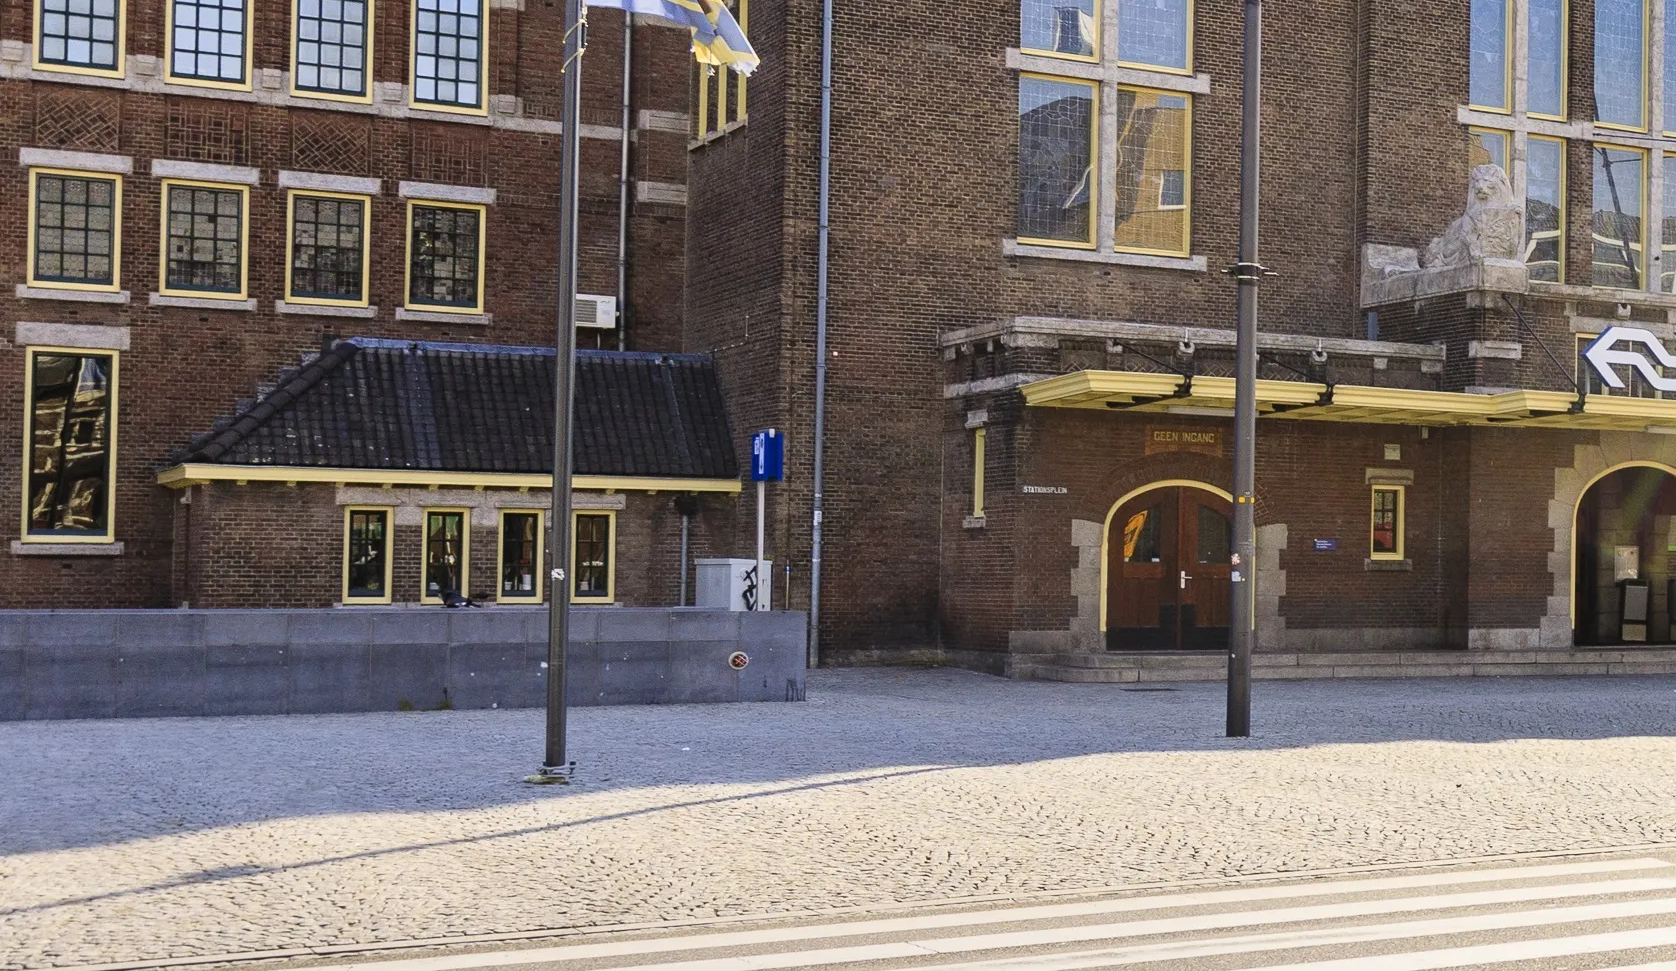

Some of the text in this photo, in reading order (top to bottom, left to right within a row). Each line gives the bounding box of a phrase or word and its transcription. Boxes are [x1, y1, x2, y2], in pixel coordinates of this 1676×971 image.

[1153, 430, 1215, 443] GEEN INGANG
[1022, 485, 1068, 494] STATIONSPLEIN
